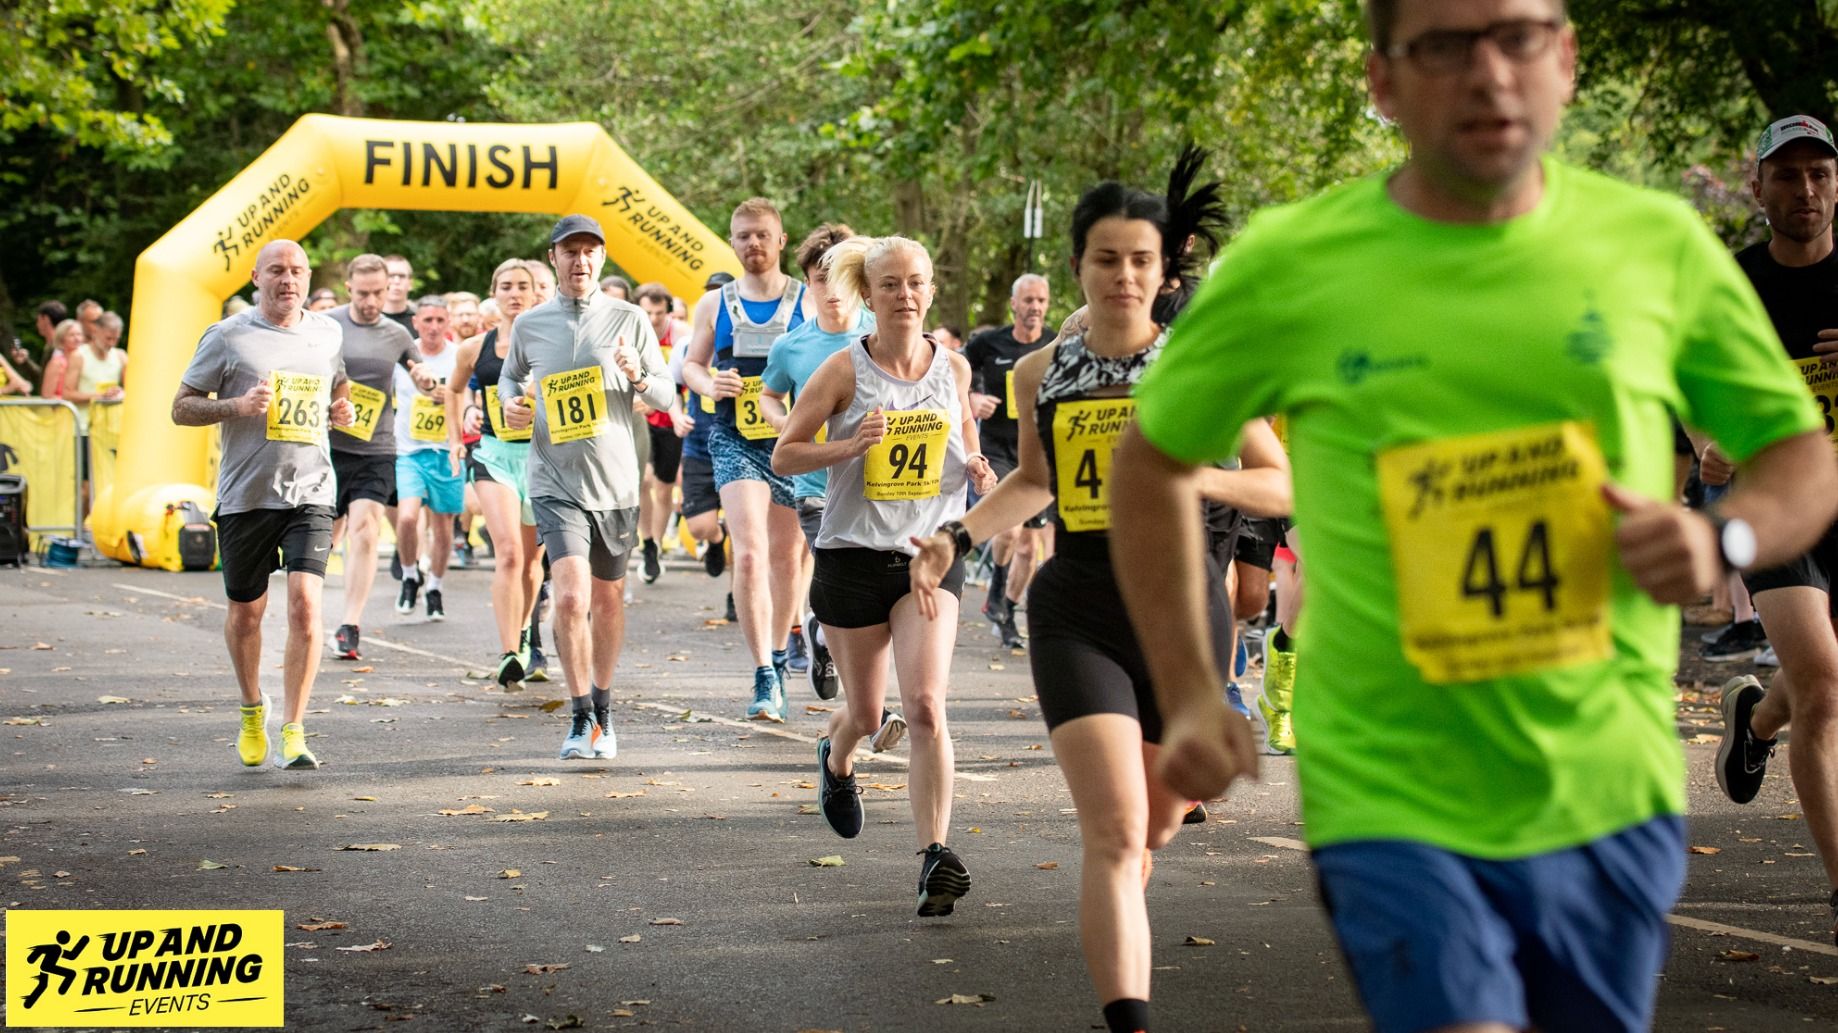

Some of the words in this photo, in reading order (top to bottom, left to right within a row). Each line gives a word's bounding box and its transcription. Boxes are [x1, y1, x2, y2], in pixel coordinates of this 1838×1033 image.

[364, 139, 558, 190] FINISH
[237, 204, 257, 228] UP
[259, 174, 290, 208] AND
[242, 178, 310, 248] RUNNING
[627, 212, 704, 271] RUNNING
[647, 205, 670, 223] UP
[668, 224, 704, 251] AND
[560, 375, 572, 384] UP
[572, 371, 590, 381] AND
[1801, 363, 1818, 375] UP
[1819, 360, 1838, 372] AN
[1806, 371, 1838, 386] UNNI
[558, 376, 595, 392] RUNNING
[278, 397, 320, 428] 263
[416, 412, 445, 431] 269
[556, 393, 597, 427] 181
[744, 400, 765, 425] 3
[900, 416, 914, 425] UP
[914, 413, 937, 423] AND
[1096, 408, 1117, 420] UP
[1118, 405, 1135, 418] A
[894, 421, 943, 436] RUNNING
[889, 442, 928, 480] 94
[1462, 450, 1498, 473] UP
[1506, 434, 1564, 464] AND
[1453, 457, 1580, 500] RUNNING
[1460, 519, 1561, 620] 44
